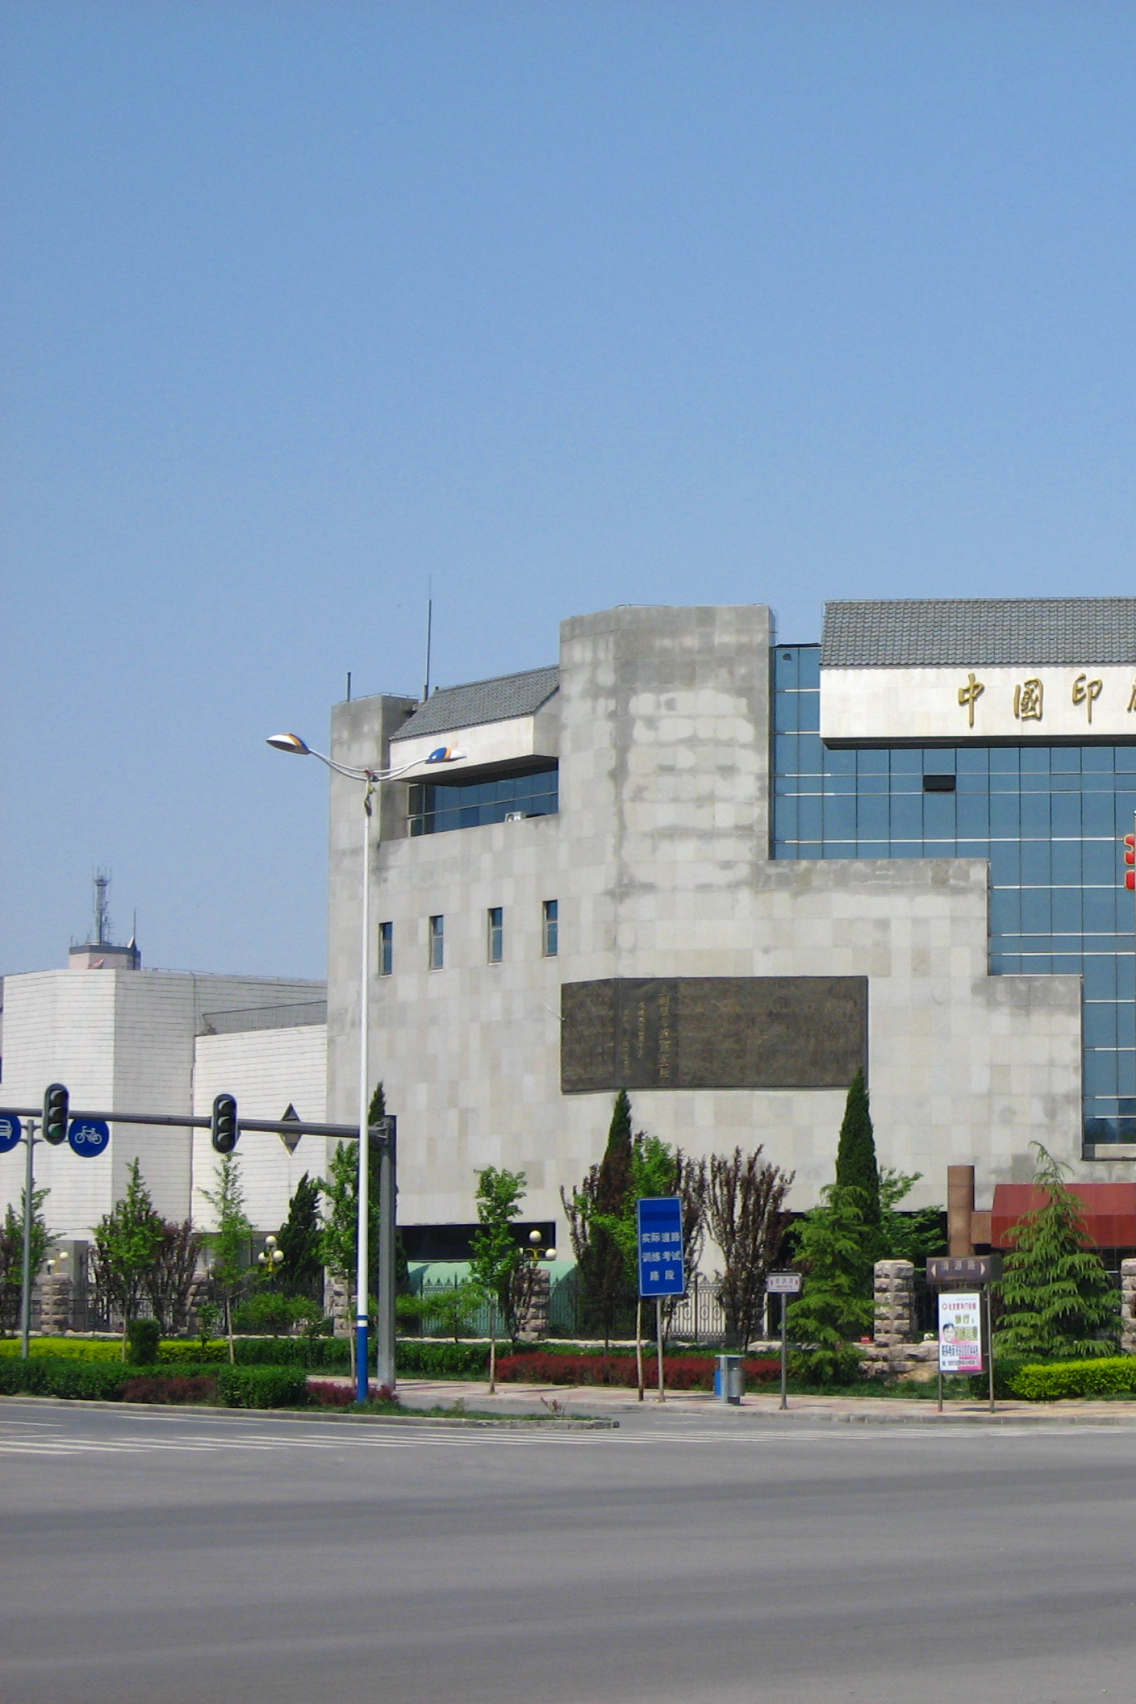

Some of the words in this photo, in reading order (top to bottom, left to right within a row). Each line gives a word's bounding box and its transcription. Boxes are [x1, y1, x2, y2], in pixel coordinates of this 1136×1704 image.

[641, 1232, 680, 1243] 实际道路
[642, 1251, 682, 1262] 训练考试
[650, 1270, 675, 1281] 路段
